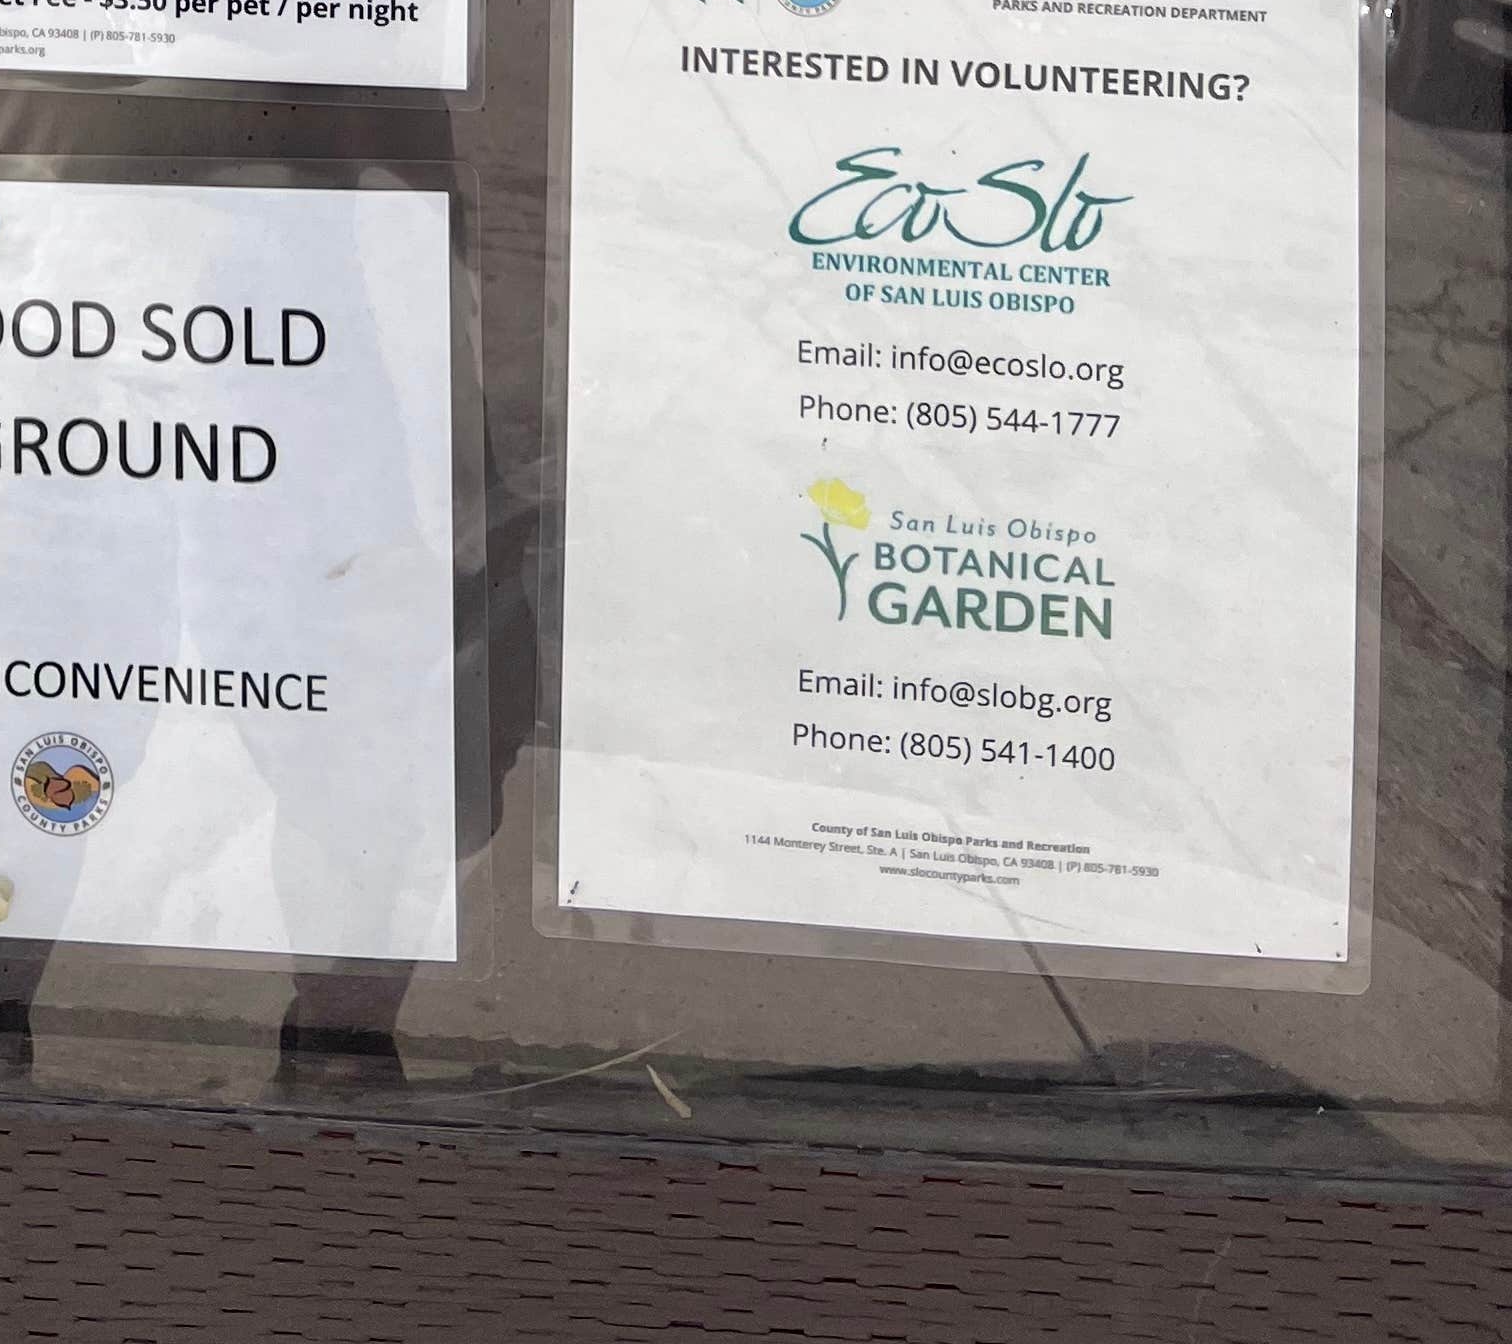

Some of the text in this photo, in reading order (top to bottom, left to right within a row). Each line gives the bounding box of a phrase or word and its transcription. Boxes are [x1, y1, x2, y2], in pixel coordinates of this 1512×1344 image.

[681, 45, 1250, 102] INTERESTED IN VOLUNTEERING?
[812, 253, 1111, 287] ENVIRONMENTAL CENTER
[141, 302, 326, 367] SOLD
[798, 339, 1125, 390] Email: info@ecoslo.org
[874, 541, 1116, 587] BOTANICAL
[867, 581, 1112, 641] GARDEN
[879, 865, 1020, 886] www.slocountyparks.com
